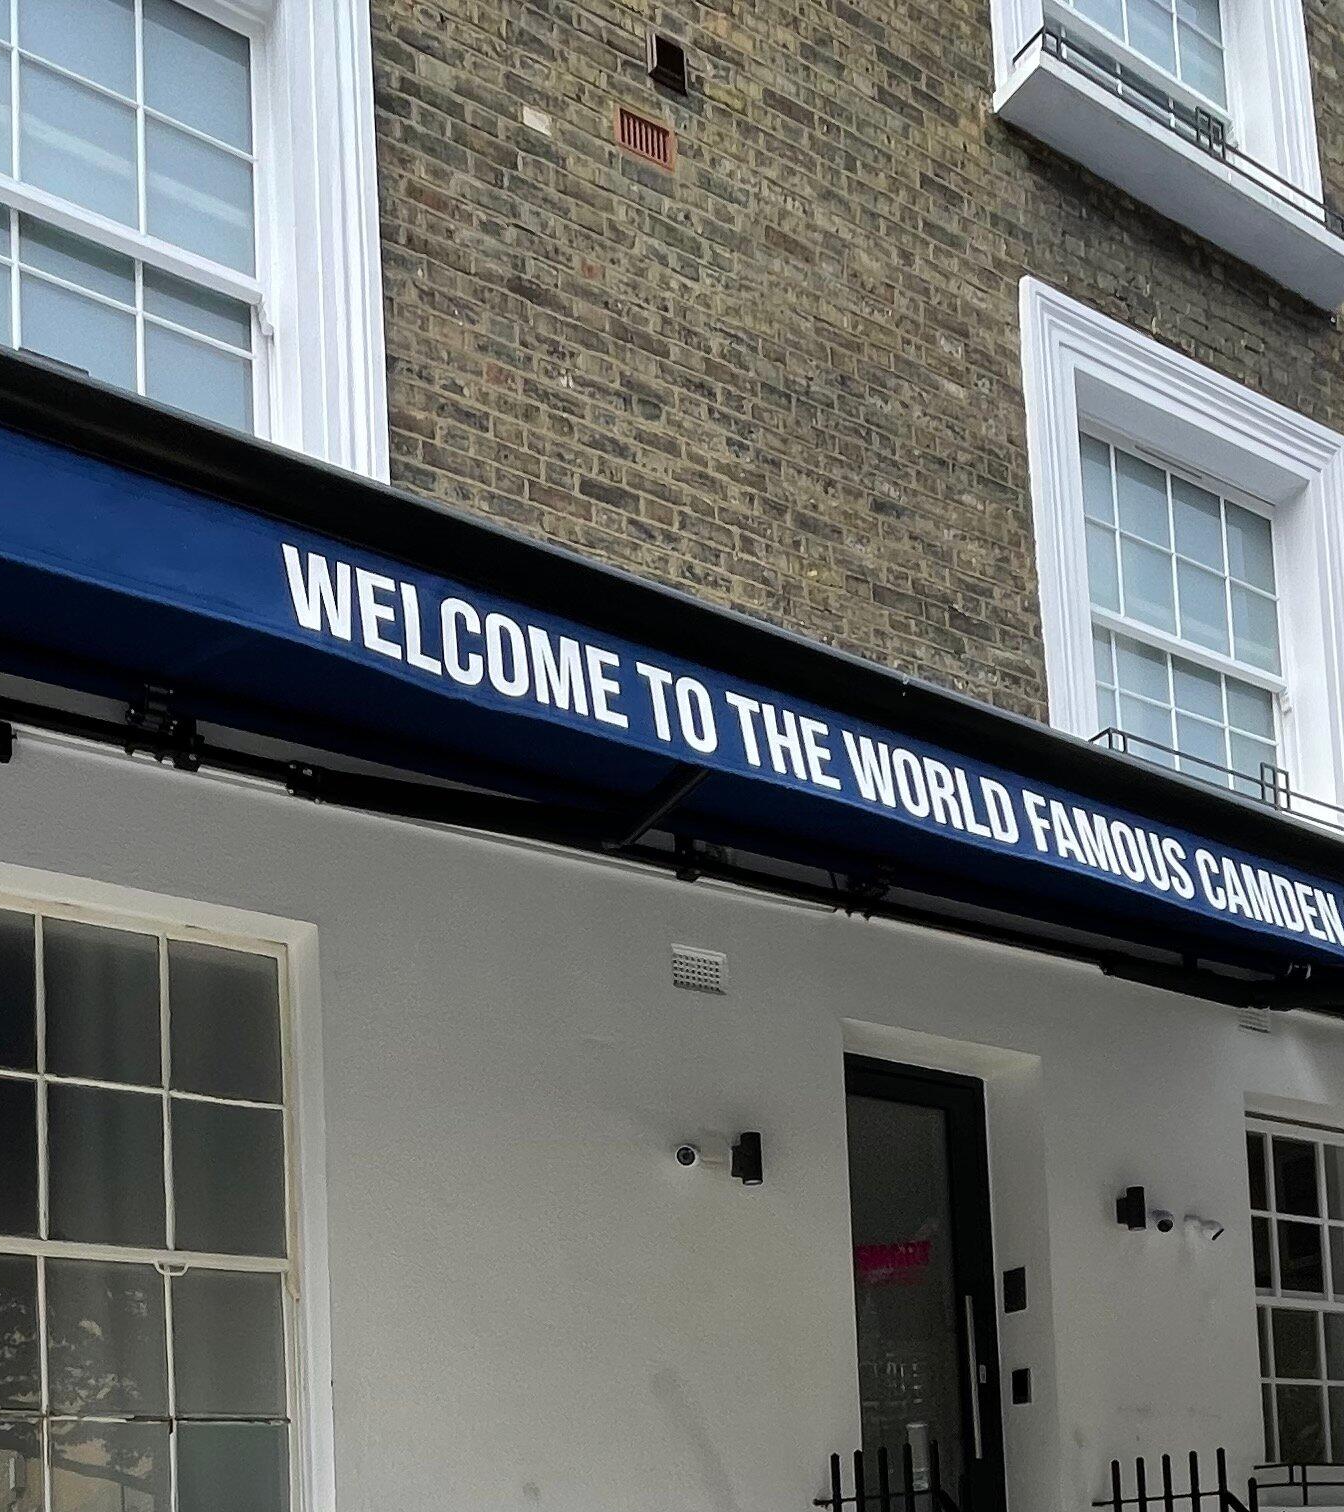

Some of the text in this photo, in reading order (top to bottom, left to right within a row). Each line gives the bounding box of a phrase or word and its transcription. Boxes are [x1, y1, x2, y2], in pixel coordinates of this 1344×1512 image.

[281, 542, 630, 730] WELCOME
[635, 660, 719, 755] TO
[724, 690, 843, 792] THE
[840, 729, 1021, 845] WORLD
[1020, 788, 1196, 901] FAMOUS
